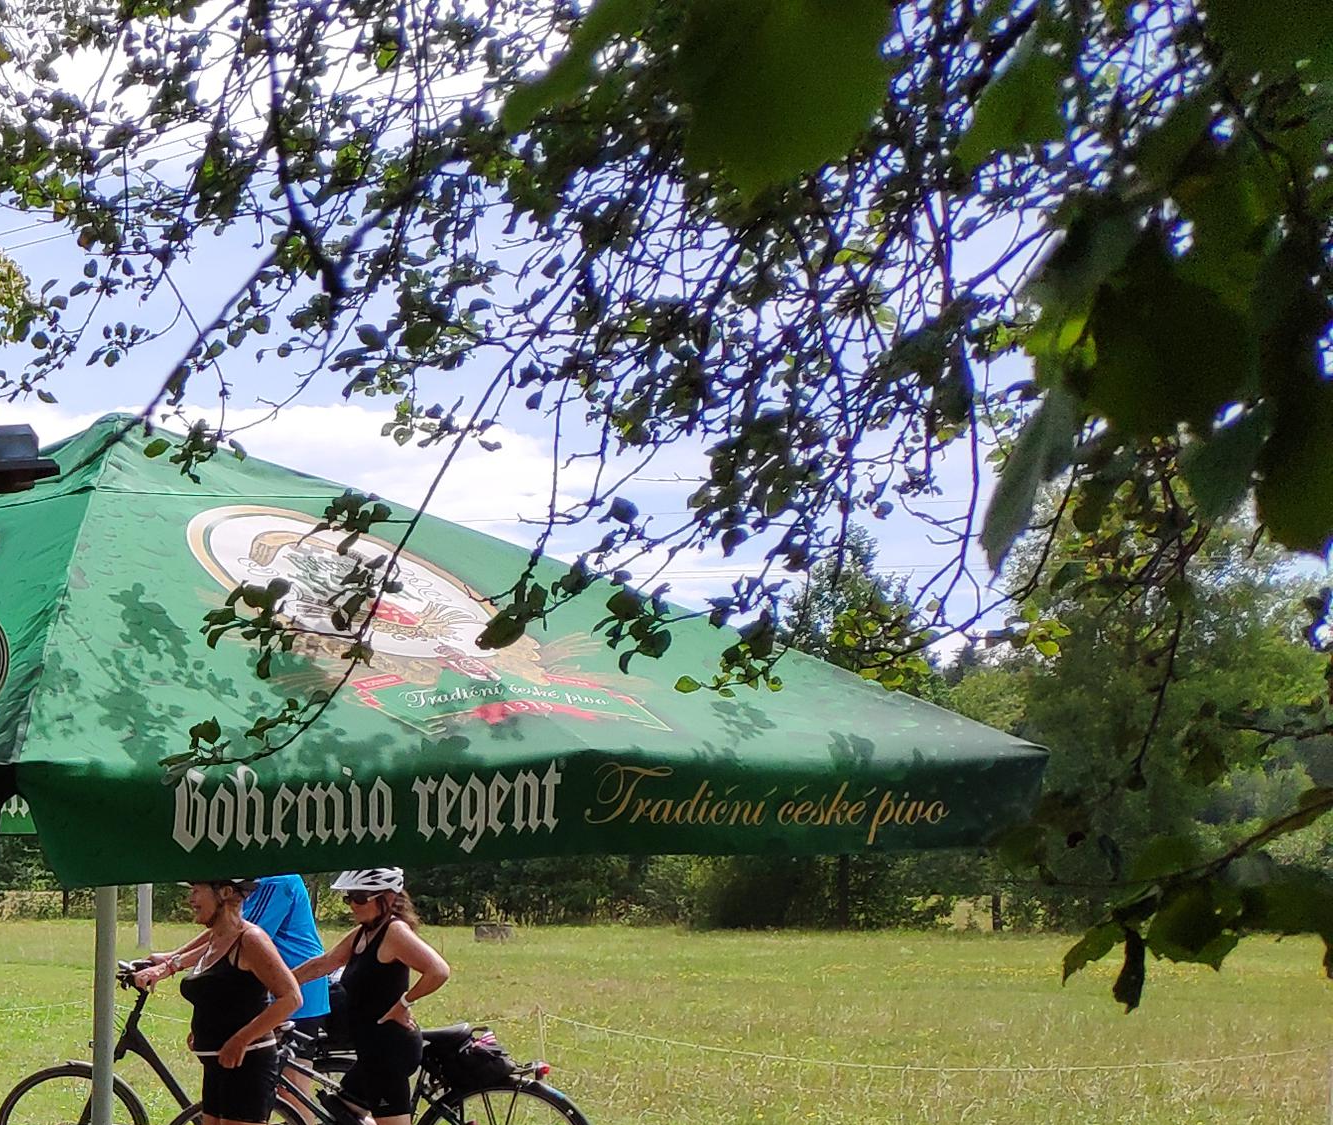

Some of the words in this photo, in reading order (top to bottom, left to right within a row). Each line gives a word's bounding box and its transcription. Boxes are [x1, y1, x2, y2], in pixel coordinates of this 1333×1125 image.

[172, 764, 397, 853] Bohemia
[411, 759, 562, 853] regent
[584, 762, 777, 827] Tradiční
[777, 780, 877, 827] české
[866, 788, 950, 845] pivo
